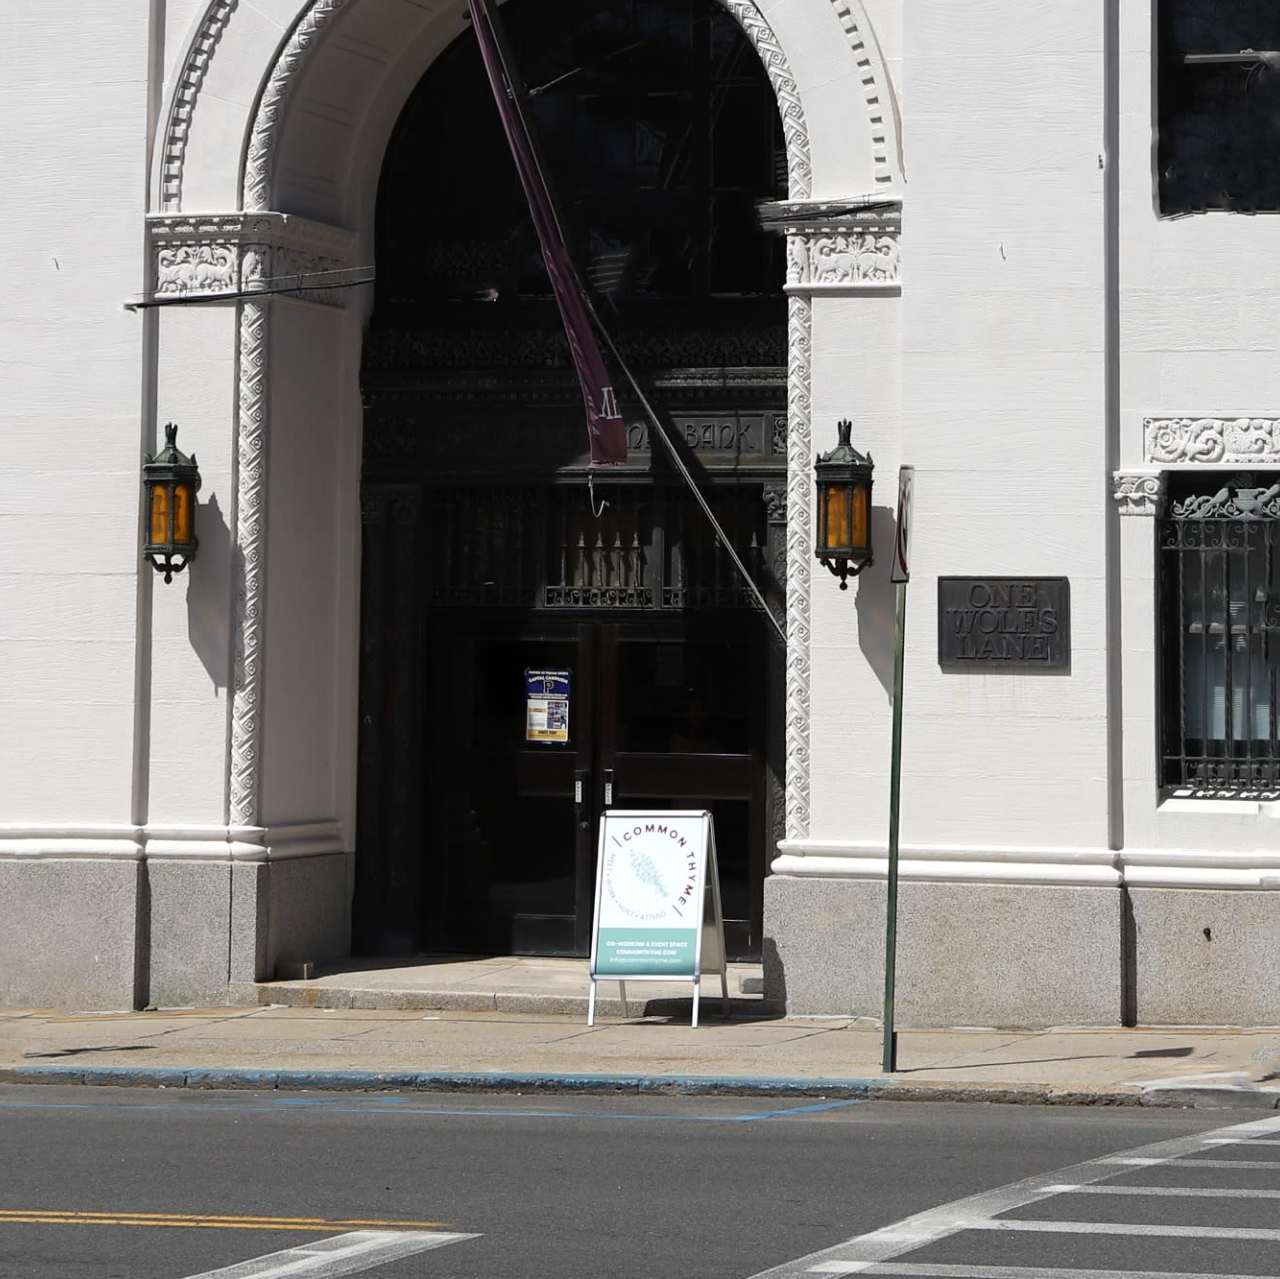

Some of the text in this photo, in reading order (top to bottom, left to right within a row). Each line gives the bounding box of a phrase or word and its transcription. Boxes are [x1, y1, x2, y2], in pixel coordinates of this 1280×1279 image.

[686, 423, 756, 450] BANK
[969, 583, 1038, 609] ONE
[945, 608, 1058, 635] WOLFS
[954, 634, 1049, 660] LANE
[623, 823, 697, 906] COMMON THYME
